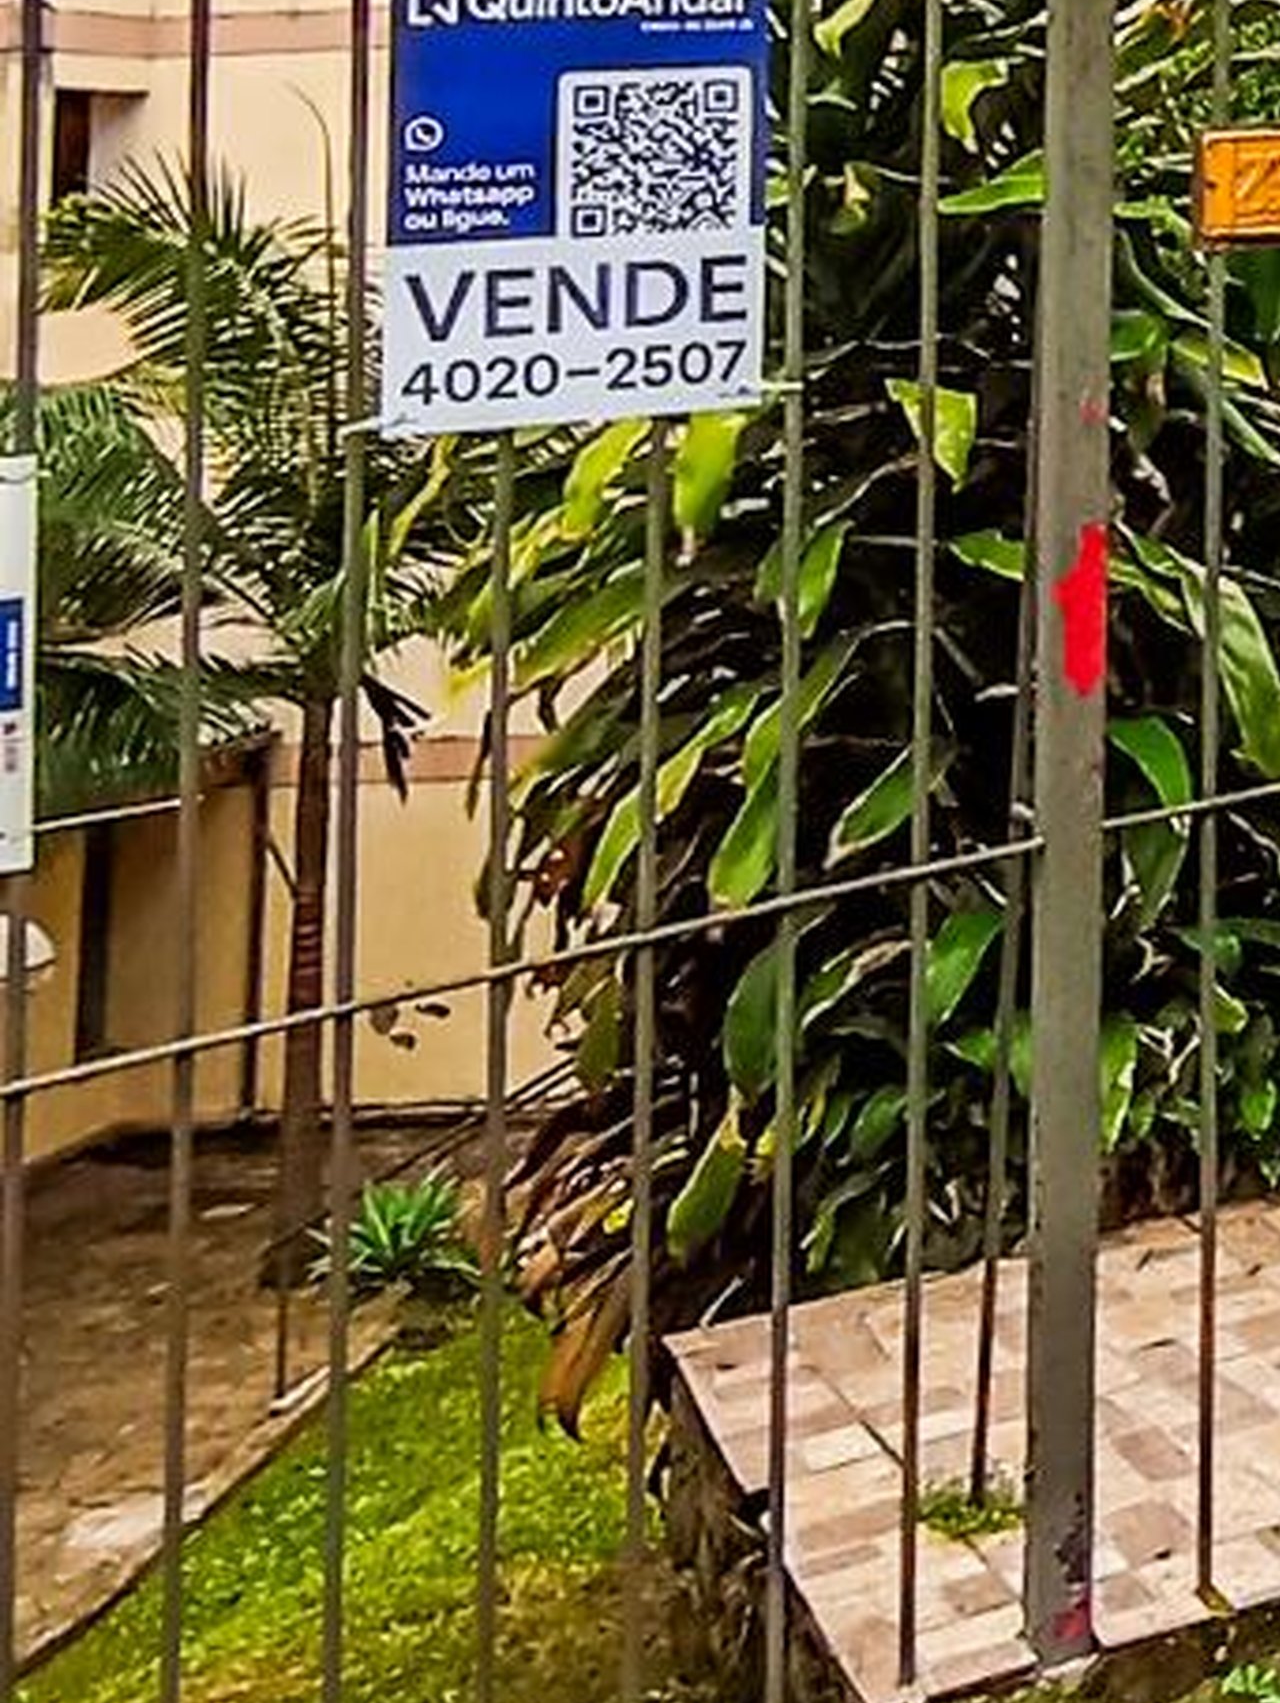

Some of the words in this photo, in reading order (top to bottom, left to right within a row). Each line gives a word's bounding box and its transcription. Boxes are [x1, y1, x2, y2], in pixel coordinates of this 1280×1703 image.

[404, 163, 491, 184] Mande
[495, 163, 534, 180] um
[404, 213, 437, 230] ou
[405, 254, 748, 344] VENDE
[400, 341, 748, 406] 4020-2507
